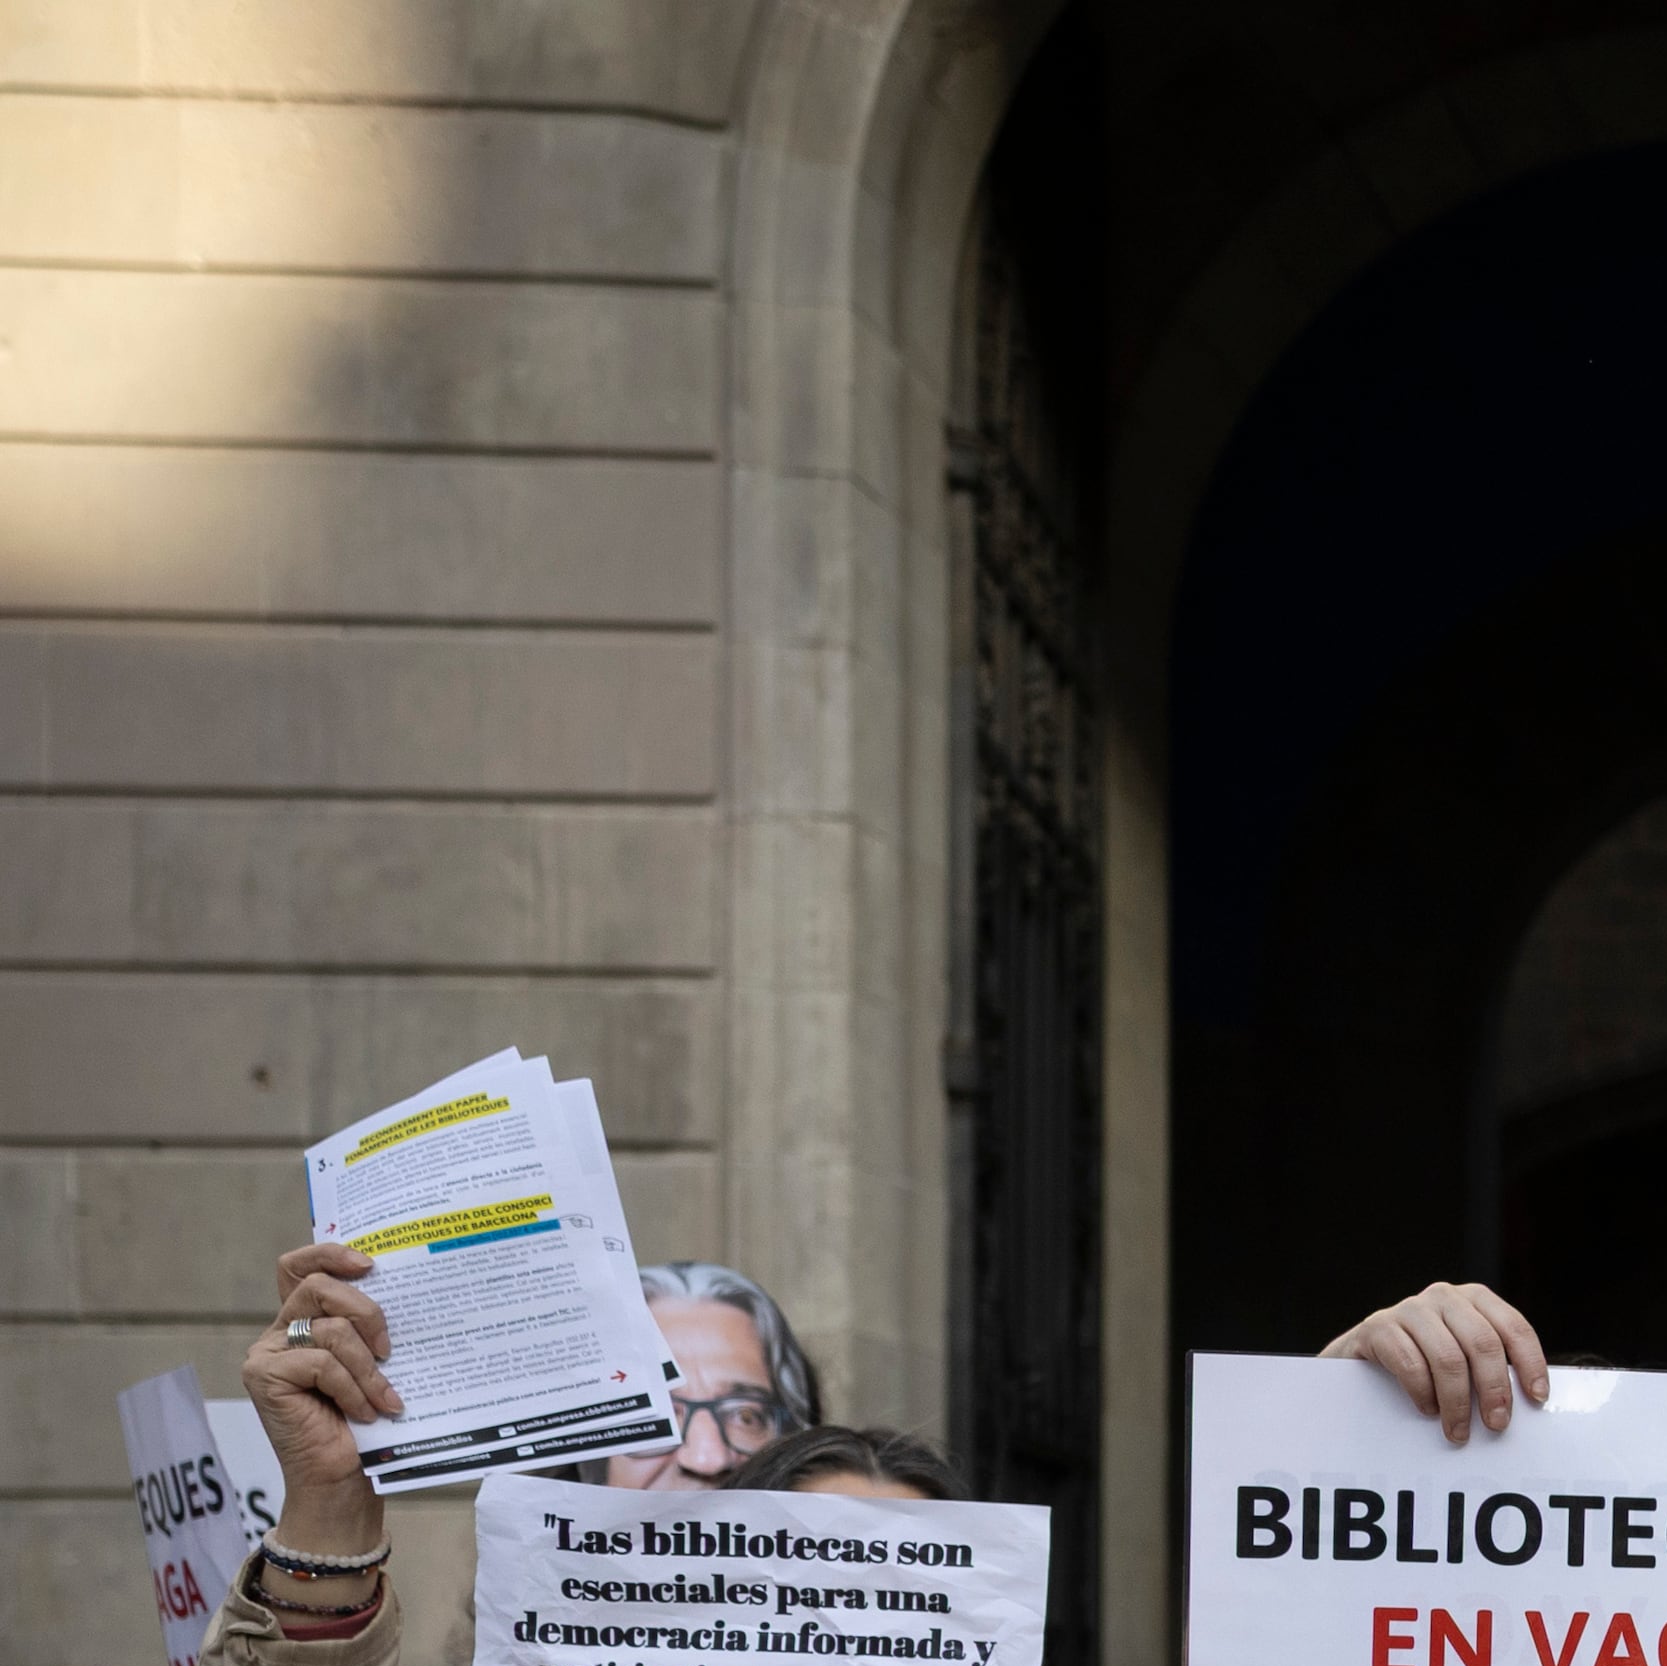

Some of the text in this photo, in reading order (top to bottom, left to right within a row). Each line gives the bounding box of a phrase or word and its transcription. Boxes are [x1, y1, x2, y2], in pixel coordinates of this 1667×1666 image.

[376, 1227, 452, 1250] BIBLIOTEQUES
[454, 1224, 469, 1234] DE
[471, 1211, 538, 1231] BARCELONA
[422, 1213, 470, 1229] NEFASTA
[473, 1208, 493, 1218] DEL
[496, 1196, 552, 1214] CONSORCI
[545, 1513, 973, 1567] "Las bibliotecas son
[561, 1574, 951, 1615] esenciales para una
[514, 1611, 749, 1651] democracia
[756, 1622, 966, 1660] informada
